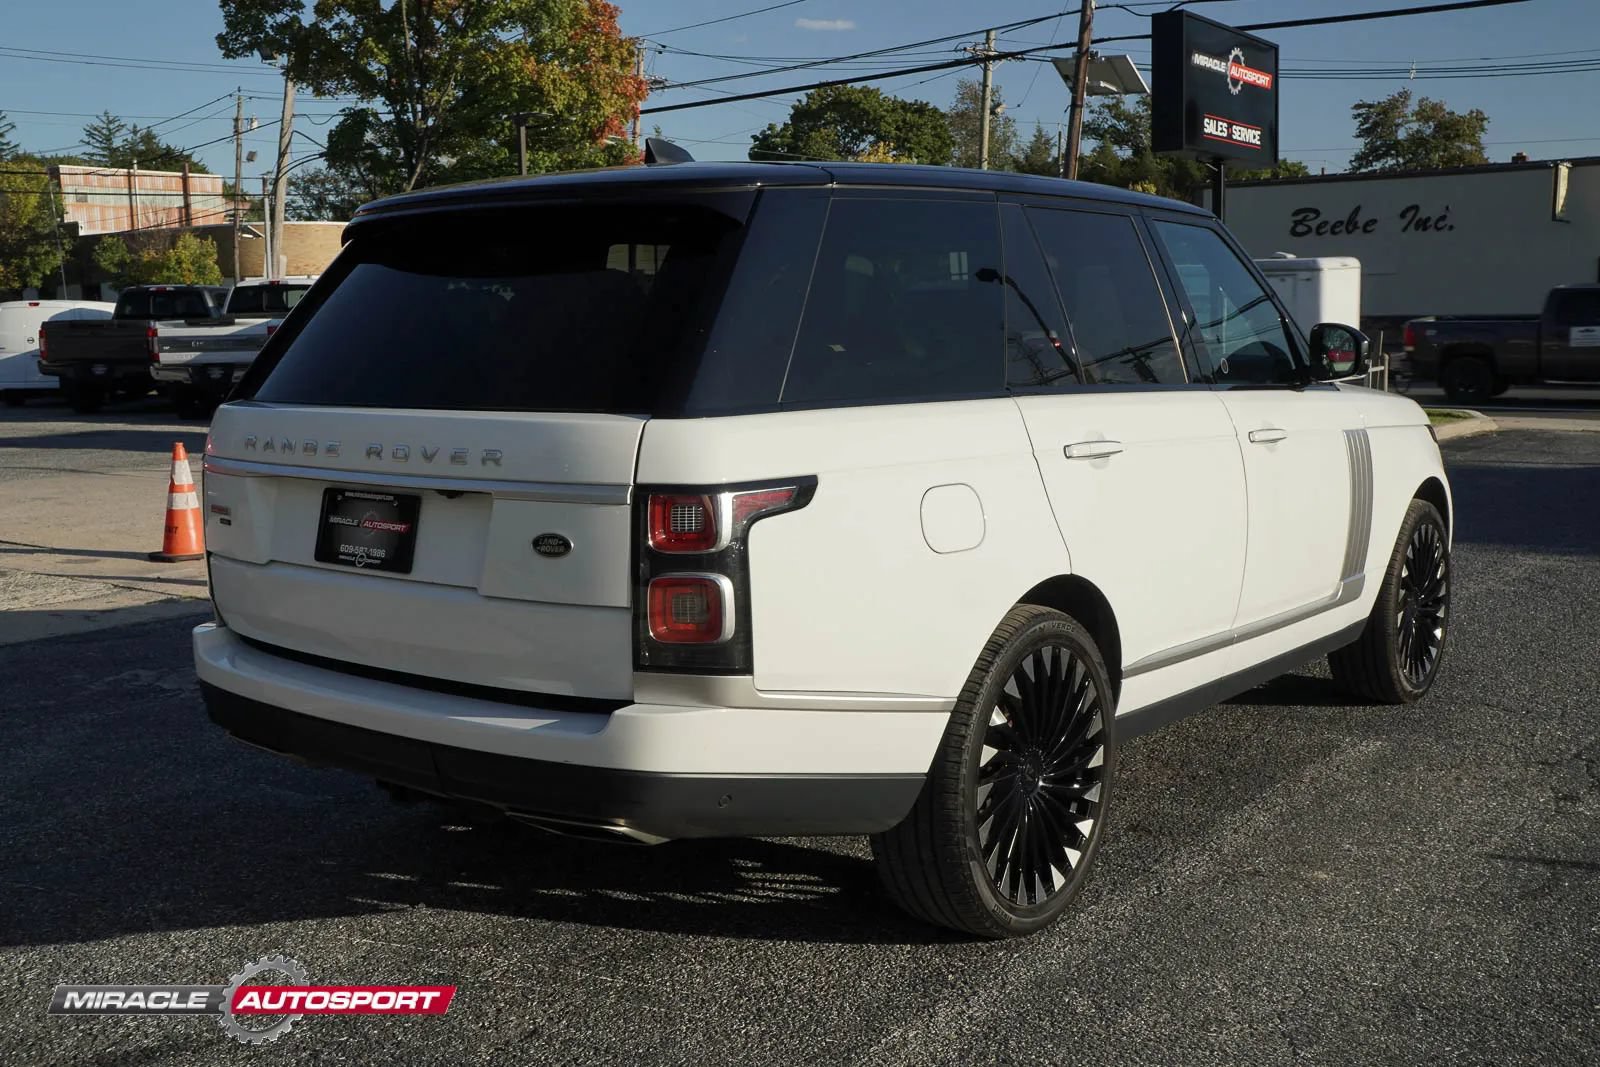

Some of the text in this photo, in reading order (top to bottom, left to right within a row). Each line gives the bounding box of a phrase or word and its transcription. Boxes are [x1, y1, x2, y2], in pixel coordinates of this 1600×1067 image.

[1194, 53, 1270, 87] MIRACLE AUTOSPORT
[1203, 117, 1261, 145] SALES SERVICE
[1289, 204, 1378, 238] Beebe
[243, 435, 504, 468] RANGE ROVER
[329, 515, 407, 532] MIRACLE AUTOSPORT
[538, 537, 565, 553] LAND ROVER
